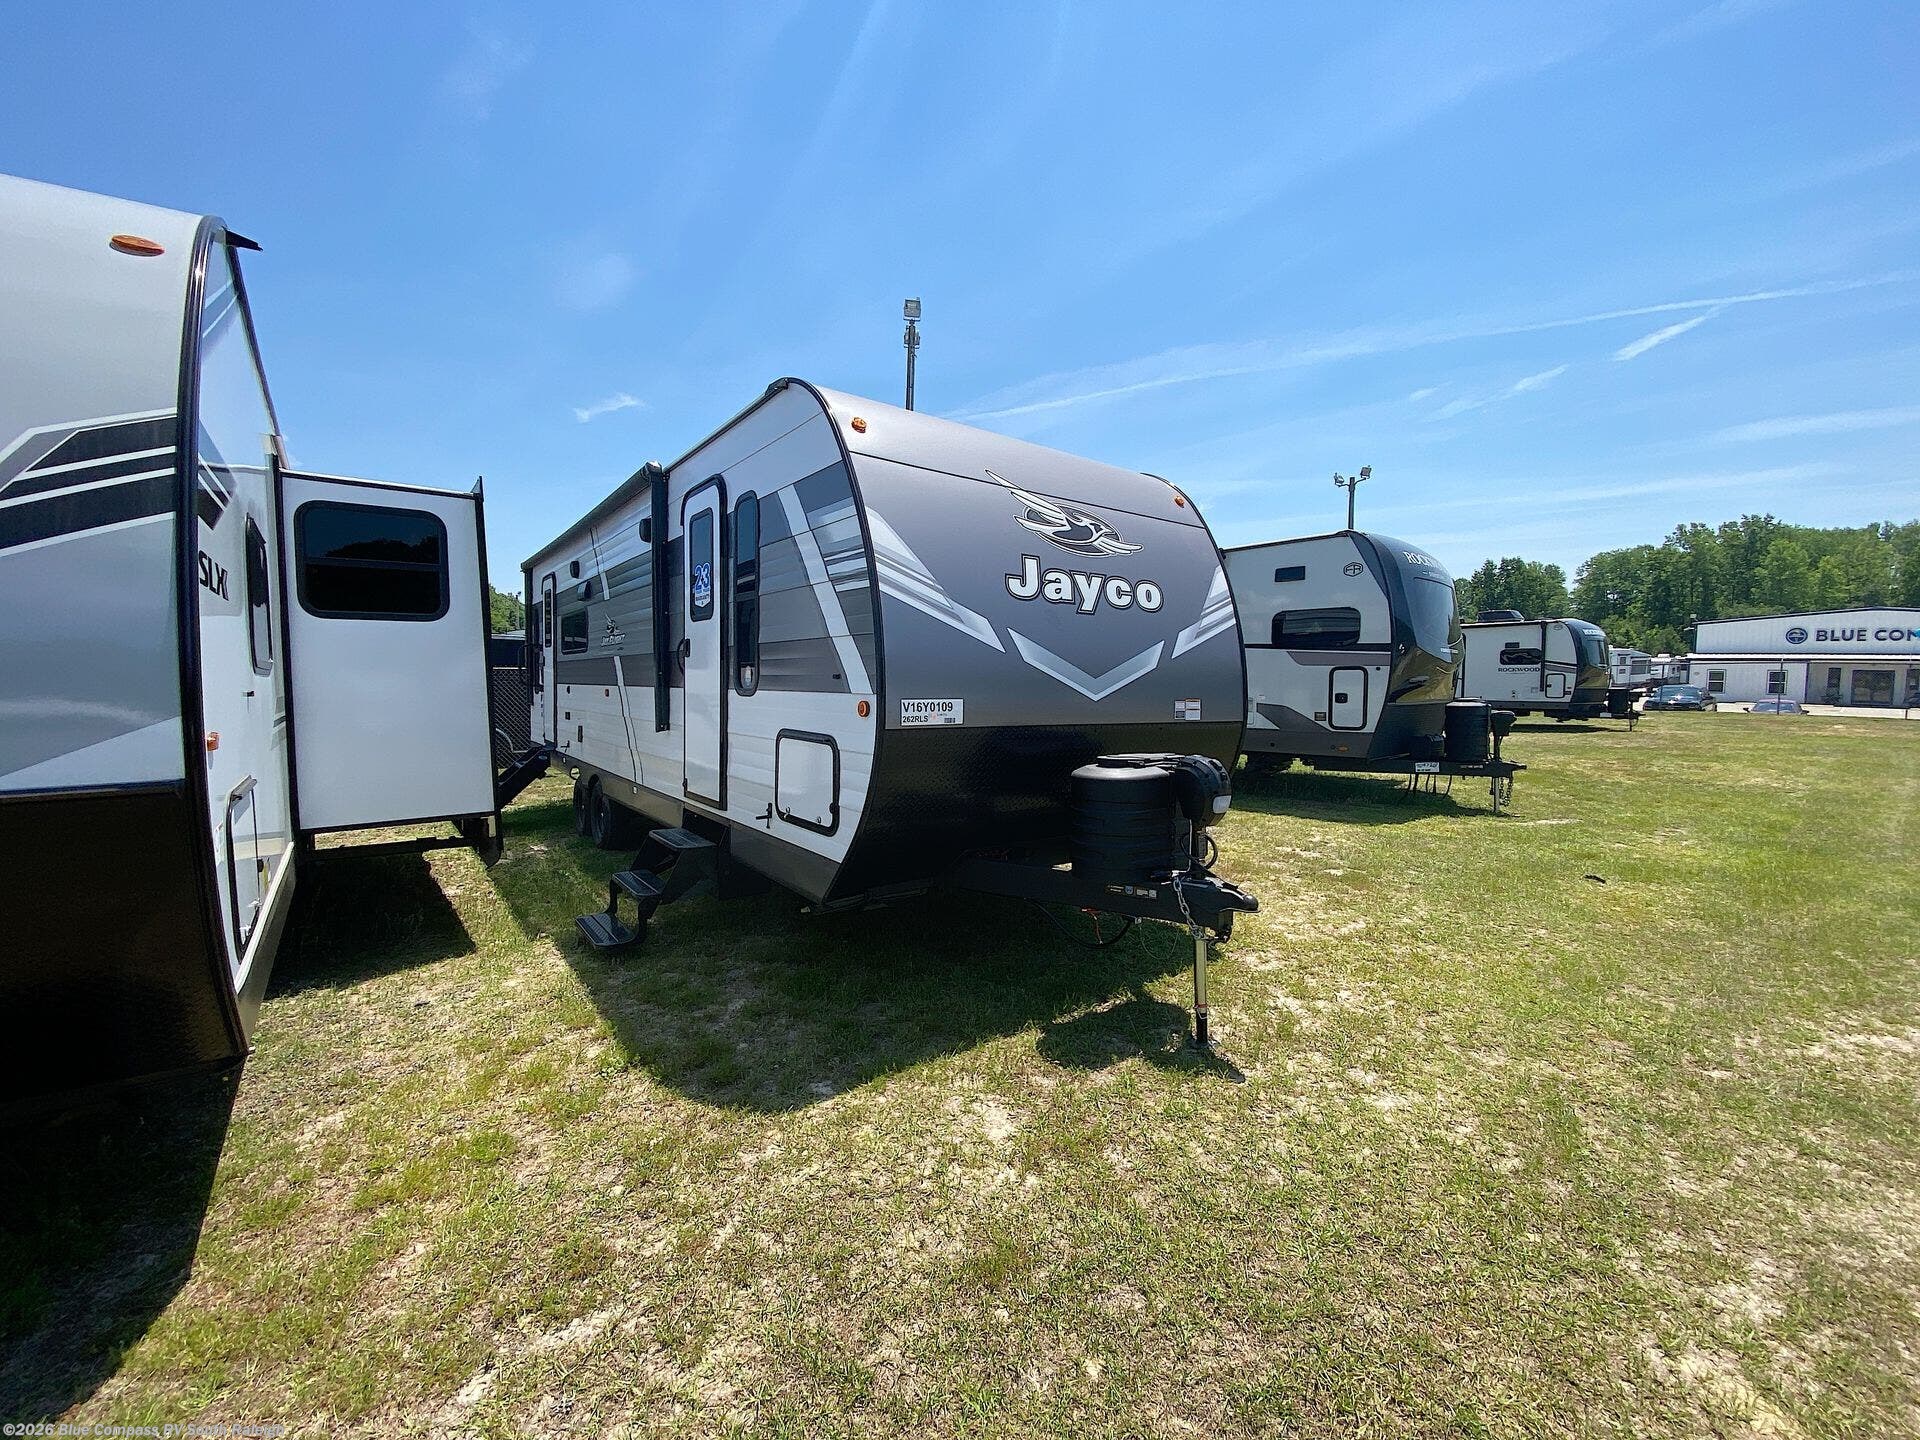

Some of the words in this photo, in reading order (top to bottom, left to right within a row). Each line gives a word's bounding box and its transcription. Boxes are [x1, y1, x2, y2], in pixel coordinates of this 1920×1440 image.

[1004, 553, 1164, 615] Jayco
[1815, 629, 1867, 641] BLUE
[902, 702, 953, 712] V16Y0109
[902, 715, 929, 723] 262RLS
